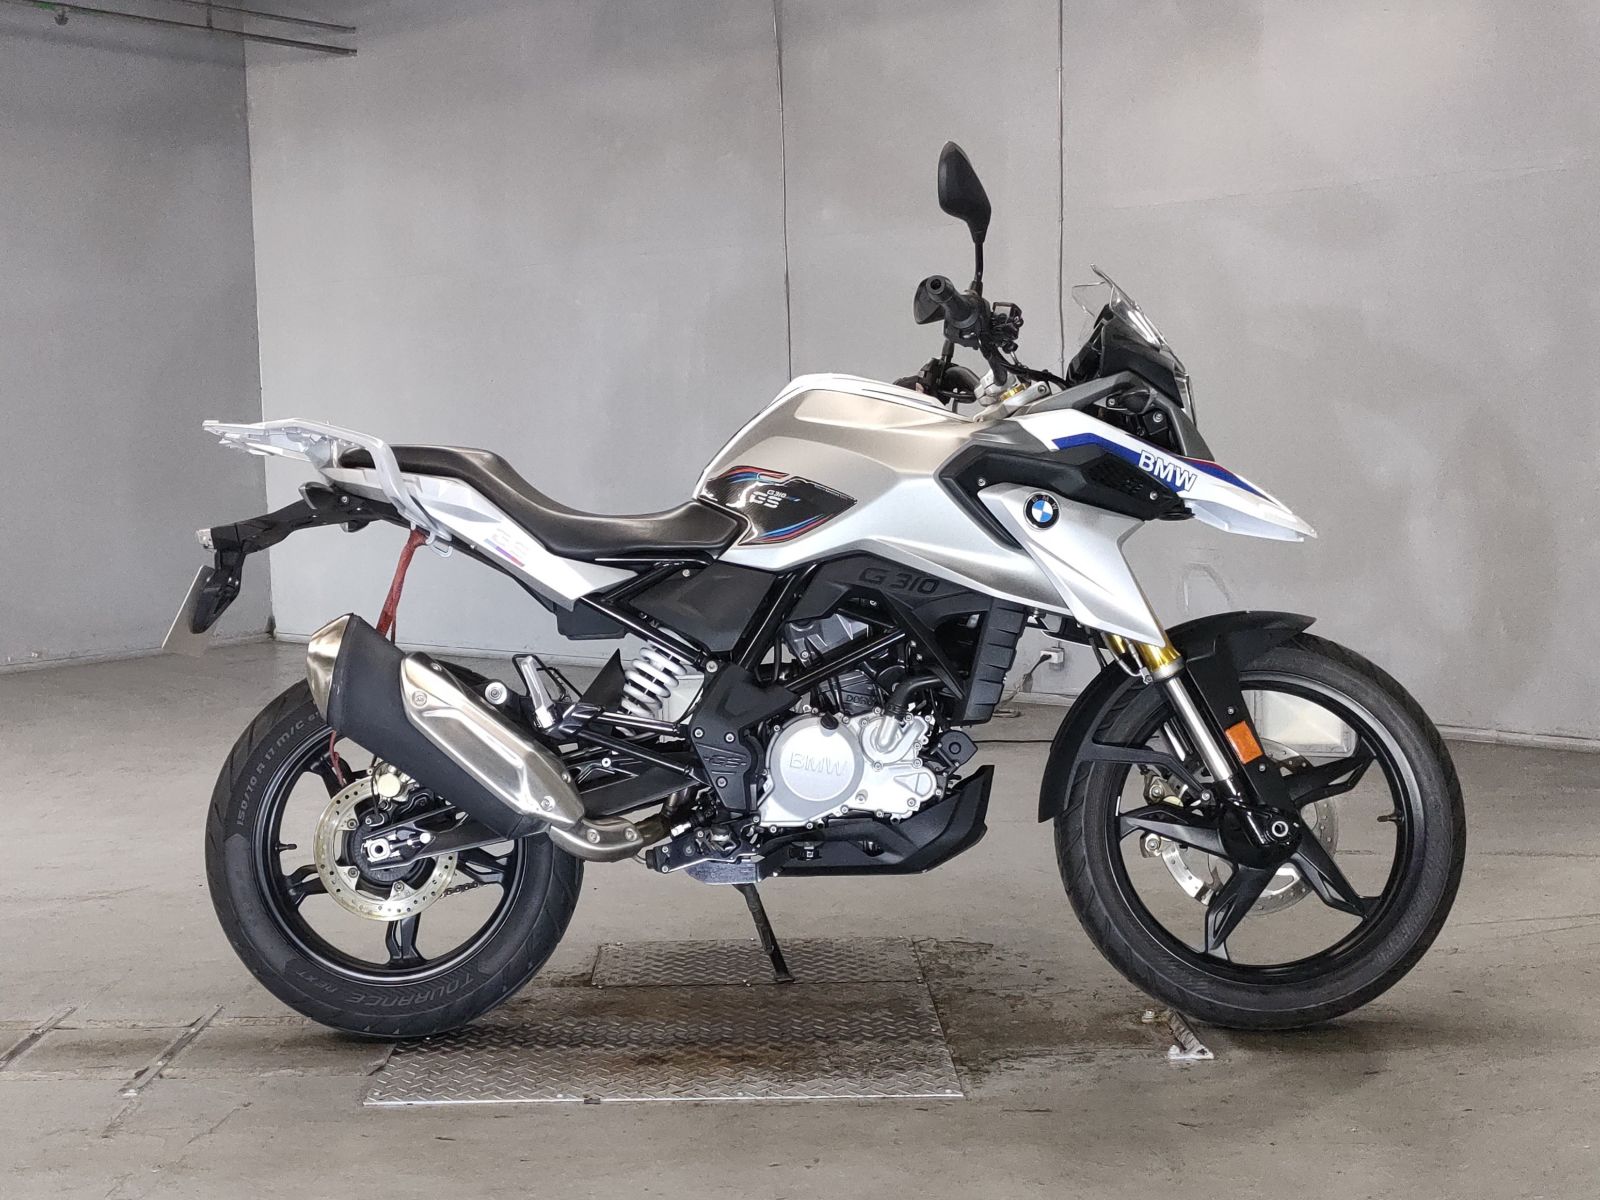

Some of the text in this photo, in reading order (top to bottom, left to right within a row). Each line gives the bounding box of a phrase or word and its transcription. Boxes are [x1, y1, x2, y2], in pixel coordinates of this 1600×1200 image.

[1138, 449, 1197, 492] BMW
[749, 491, 782, 508] GS
[858, 567, 940, 595] G 310
[276, 720, 305, 747] M/C
[789, 752, 847, 776] BMW
[295, 969, 474, 1007] TOURANCE NEXT
